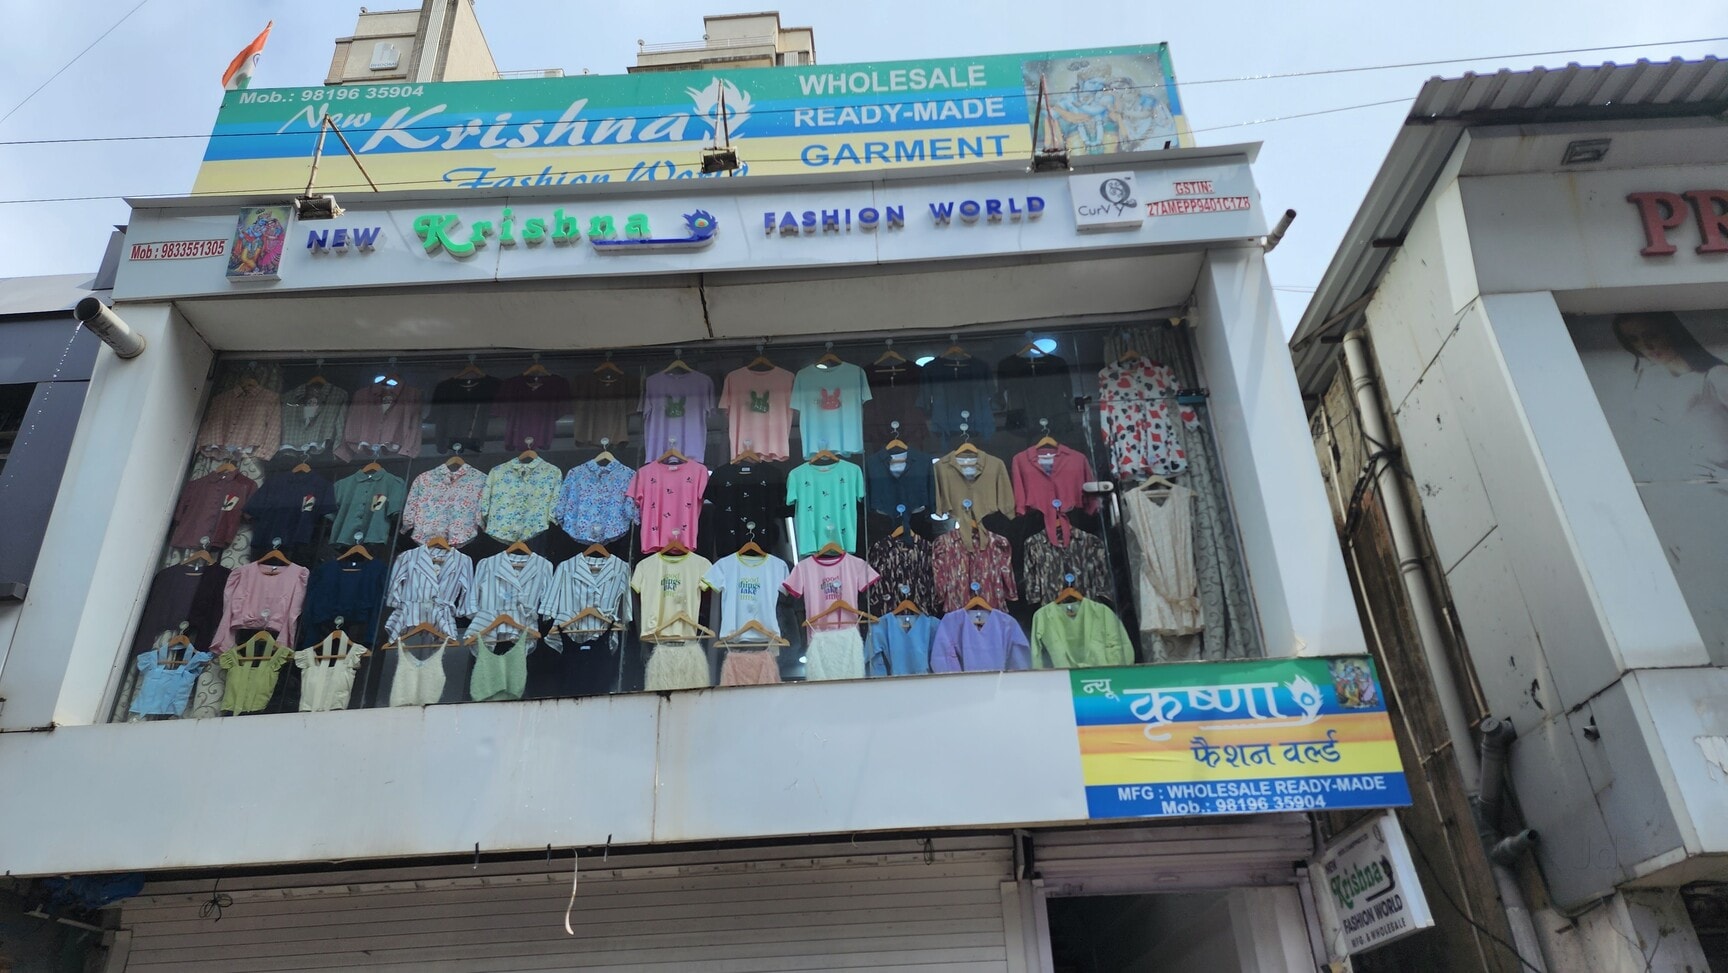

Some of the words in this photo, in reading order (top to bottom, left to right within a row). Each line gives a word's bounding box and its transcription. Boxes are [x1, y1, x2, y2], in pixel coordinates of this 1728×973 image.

[239, 91, 294, 104] Mob.:
[301, 88, 360, 102] 98196
[365, 85, 424, 99] 35904
[799, 65, 987, 96] WHOLESALE
[276, 102, 372, 135] New
[359, 98, 691, 152] Krishna
[794, 97, 1006, 128] READY-MADE
[800, 134, 1010, 168] GARMENT
[1175, 181, 1213, 195] GSTIN:
[764, 205, 905, 231] FASHION
[929, 196, 1045, 222] WORLD
[307, 227, 382, 251] NEW
[413, 207, 651, 257] Krishna
[130, 244, 152, 260] Mob
[160, 240, 224, 258] 9833551305
[1080, 678, 1120, 702] न्यू
[1122, 682, 1287, 741] कृष्णा
[1190, 736, 1275, 768] फैशन
[1279, 729, 1341, 765] वर्ल्ड
[1118, 786, 1154, 801] MFG
[1166, 780, 1273, 799] WHOLESALE
[1276, 776, 1387, 795] READY-MADE
[1161, 800, 1211, 815] Mob.:
[1216, 797, 1268, 813] 98196
[1273, 794, 1326, 811] 35904
[1330, 861, 1384, 910] Krishna
[1343, 906, 1376, 934] FASHION
[1373, 894, 1404, 920] WORLD
